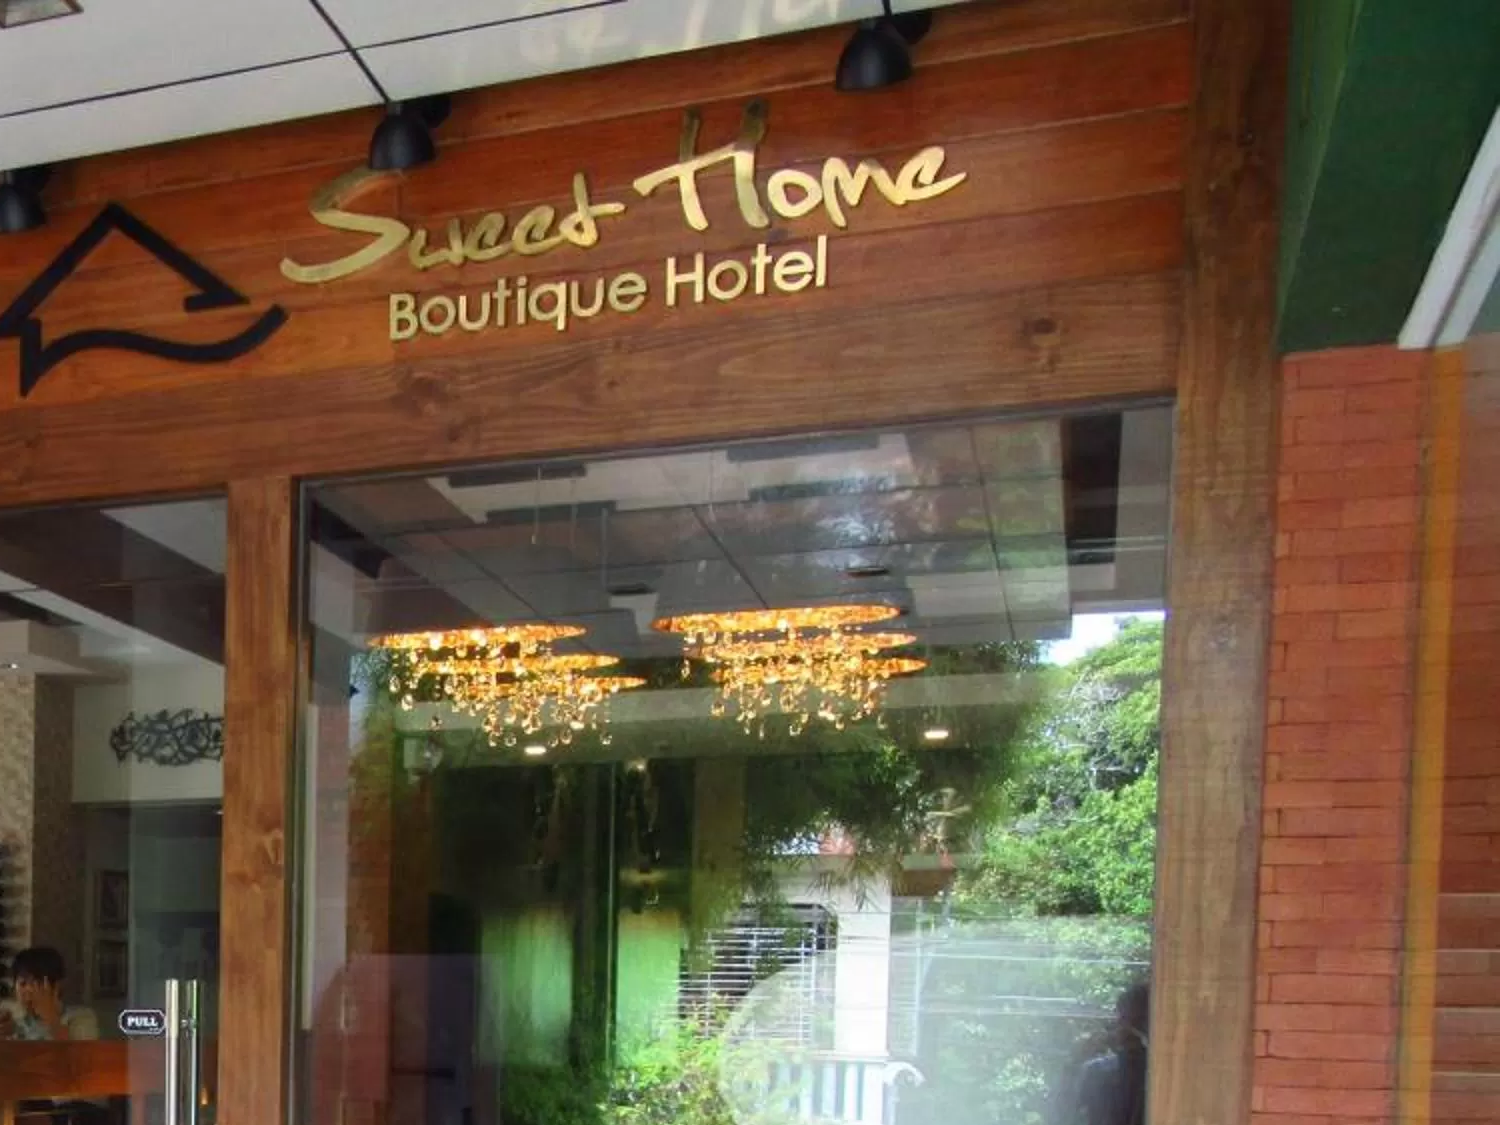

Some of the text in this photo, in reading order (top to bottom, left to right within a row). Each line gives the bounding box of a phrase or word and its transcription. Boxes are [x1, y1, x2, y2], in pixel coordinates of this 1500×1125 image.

[280, 101, 967, 284] Sweet Home
[388, 235, 828, 342] Boutique Hotel
[127, 1016, 158, 1027] PULL
